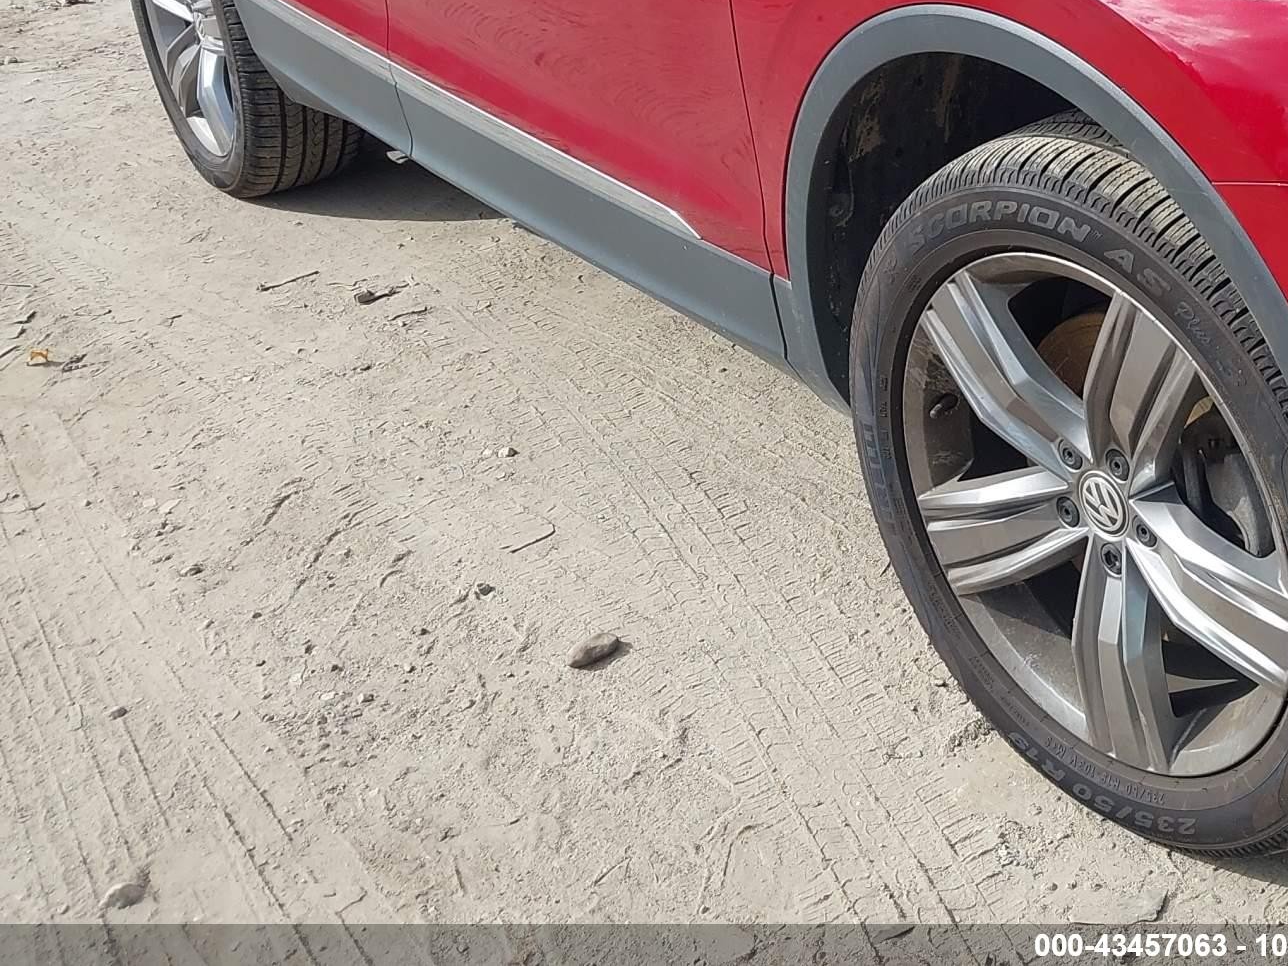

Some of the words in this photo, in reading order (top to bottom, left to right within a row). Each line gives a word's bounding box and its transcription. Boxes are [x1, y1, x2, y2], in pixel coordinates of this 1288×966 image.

[905, 200, 1092, 256] SCORPION
[1104, 248, 1172, 296] AS
[1081, 475, 1124, 533] VW
[1072, 783, 1197, 835] 235/50
